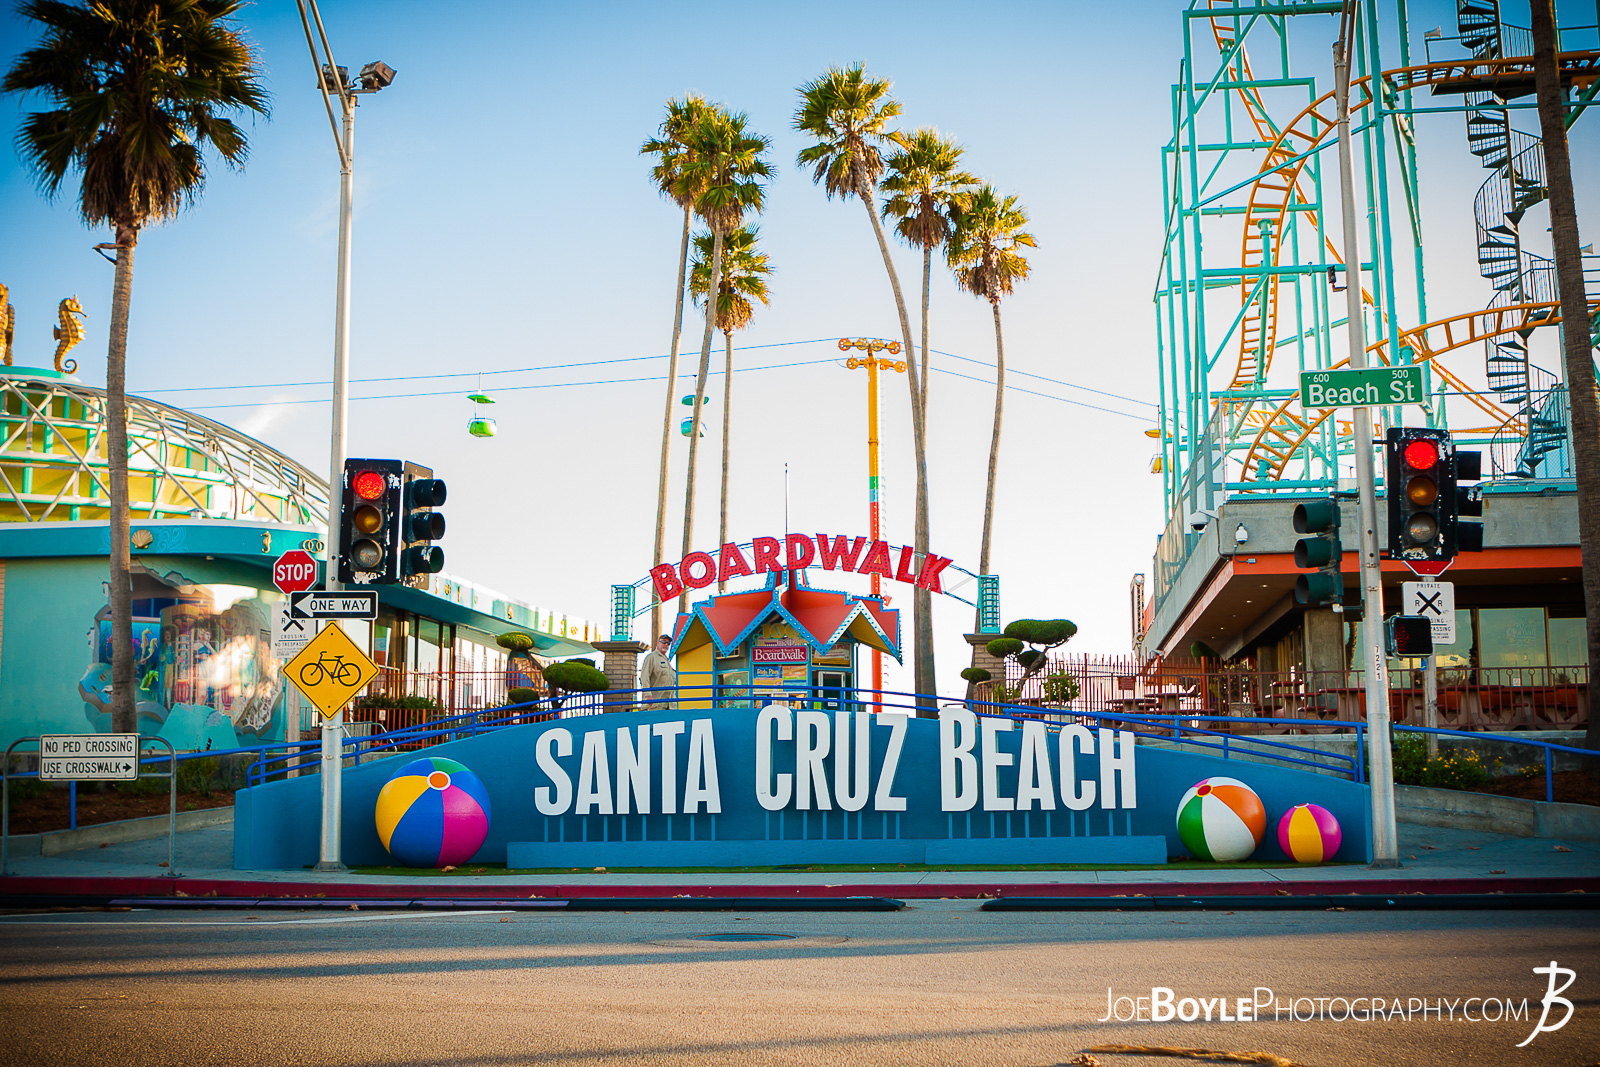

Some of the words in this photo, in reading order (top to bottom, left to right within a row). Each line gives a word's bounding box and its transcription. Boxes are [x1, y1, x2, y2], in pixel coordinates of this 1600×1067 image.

[1313, 373, 1330, 383] 600
[1391, 369, 1409, 379] 500
[1308, 382, 1379, 406] Beach
[1389, 380, 1415, 402] St
[276, 563, 314, 582] STOP
[650, 533, 953, 602] BOARDWALK
[310, 599, 335, 611] ONE
[341, 599, 368, 611] WAY
[1414, 599, 1421, 607] R
[1437, 599, 1443, 607] R
[754, 648, 806, 661] Boardwalk
[45, 741, 59, 753] NO
[62, 741, 81, 753] PED
[85, 740, 133, 753] CROSSING
[534, 718, 722, 815] SANTA
[755, 705, 908, 811] CRUZ
[940, 706, 1137, 811] BEACH
[43, 762, 62, 774] USE
[65, 762, 121, 774] CROSSWALK
